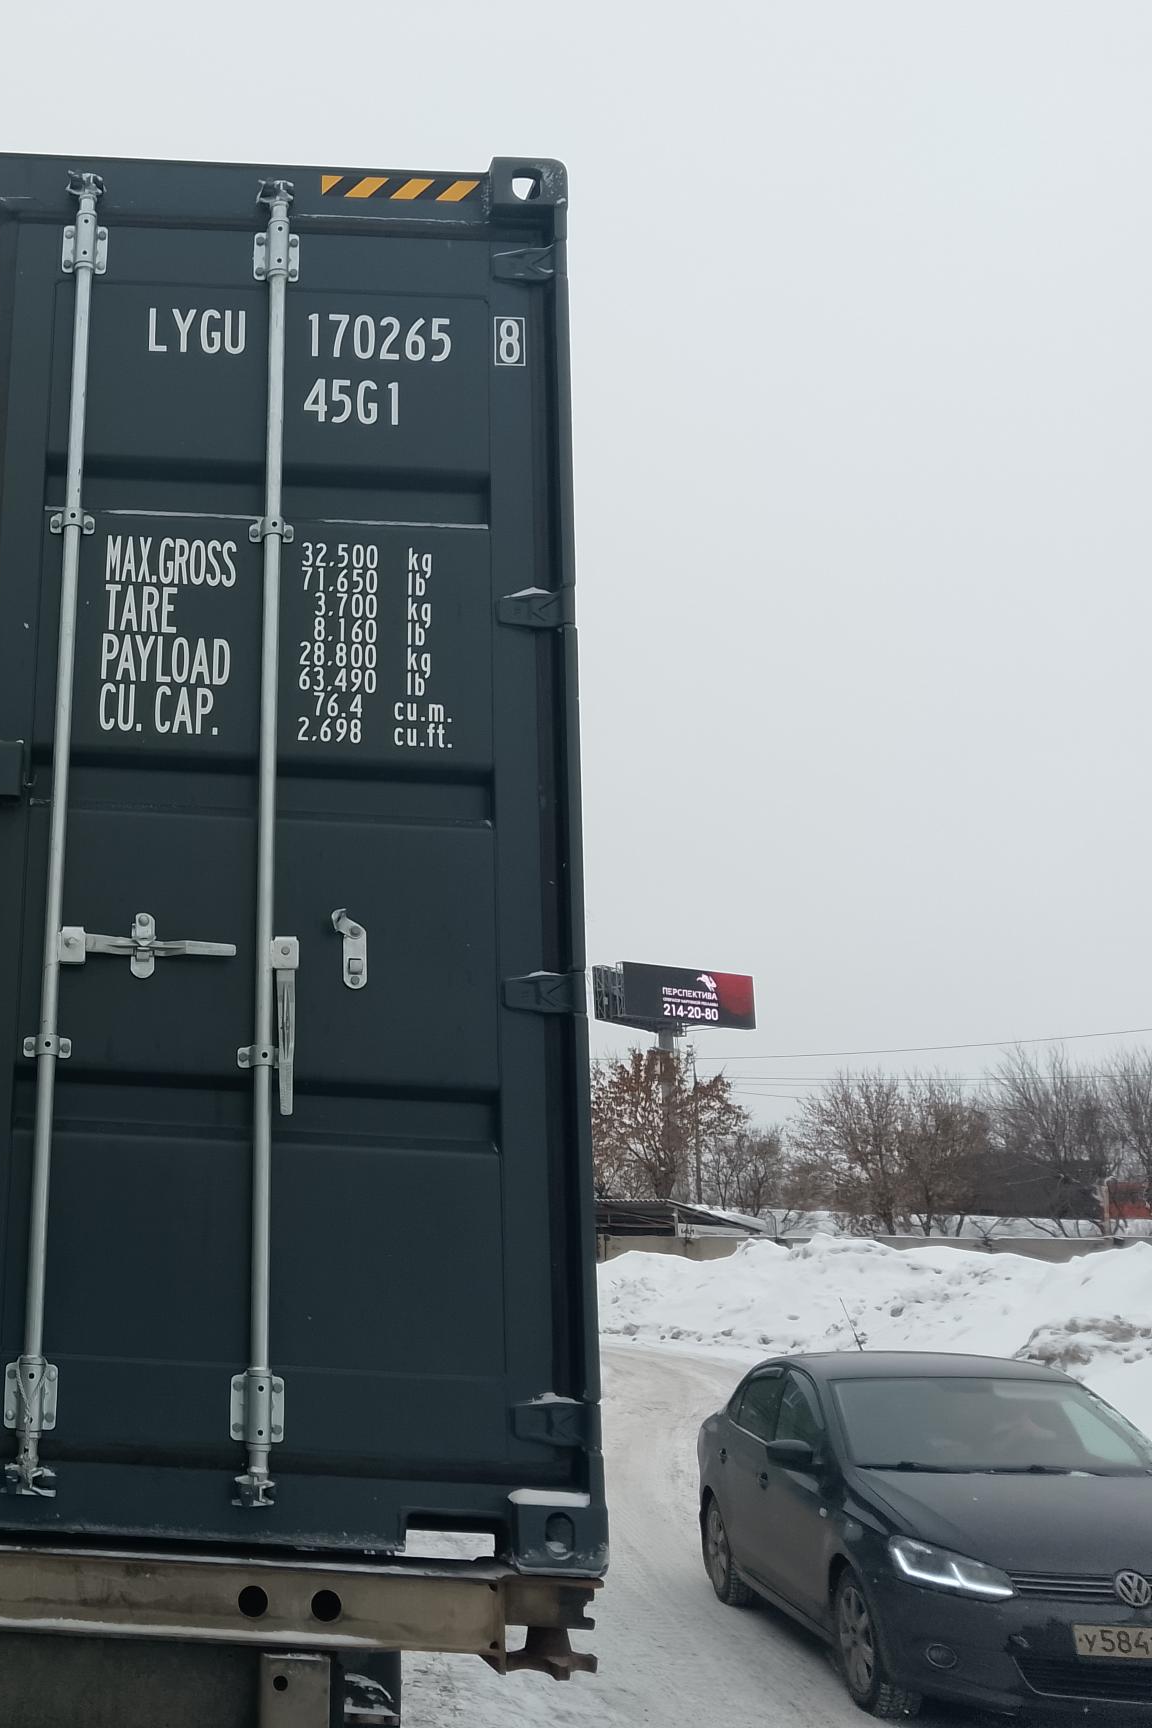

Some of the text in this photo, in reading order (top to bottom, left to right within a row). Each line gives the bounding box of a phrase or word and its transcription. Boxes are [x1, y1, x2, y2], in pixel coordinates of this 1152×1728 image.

[149, 308, 521, 363] LYGU 170265 8
[304, 379, 398, 425] 45G1
[301, 542, 432, 579] 32,500 kg
[301, 566, 426, 596] 71,650 lb
[105, 584, 178, 634] TARE
[314, 592, 432, 629] 3,700 kg
[314, 617, 426, 646] 8,160 lb
[100, 633, 231, 686] PAYLOAD
[299, 641, 431, 678] 28,800 kg
[298, 666, 426, 696] 63,490 lb
[99, 682, 219, 736] CU. CAP.
[313, 692, 453, 722] 76.4 cu.m.
[298, 716, 453, 748] 2,698 cu.ft.
[662, 987, 718, 1001] ПЕРСПЕКТИВА
[663, 1003, 718, 1020] 214-20-80
